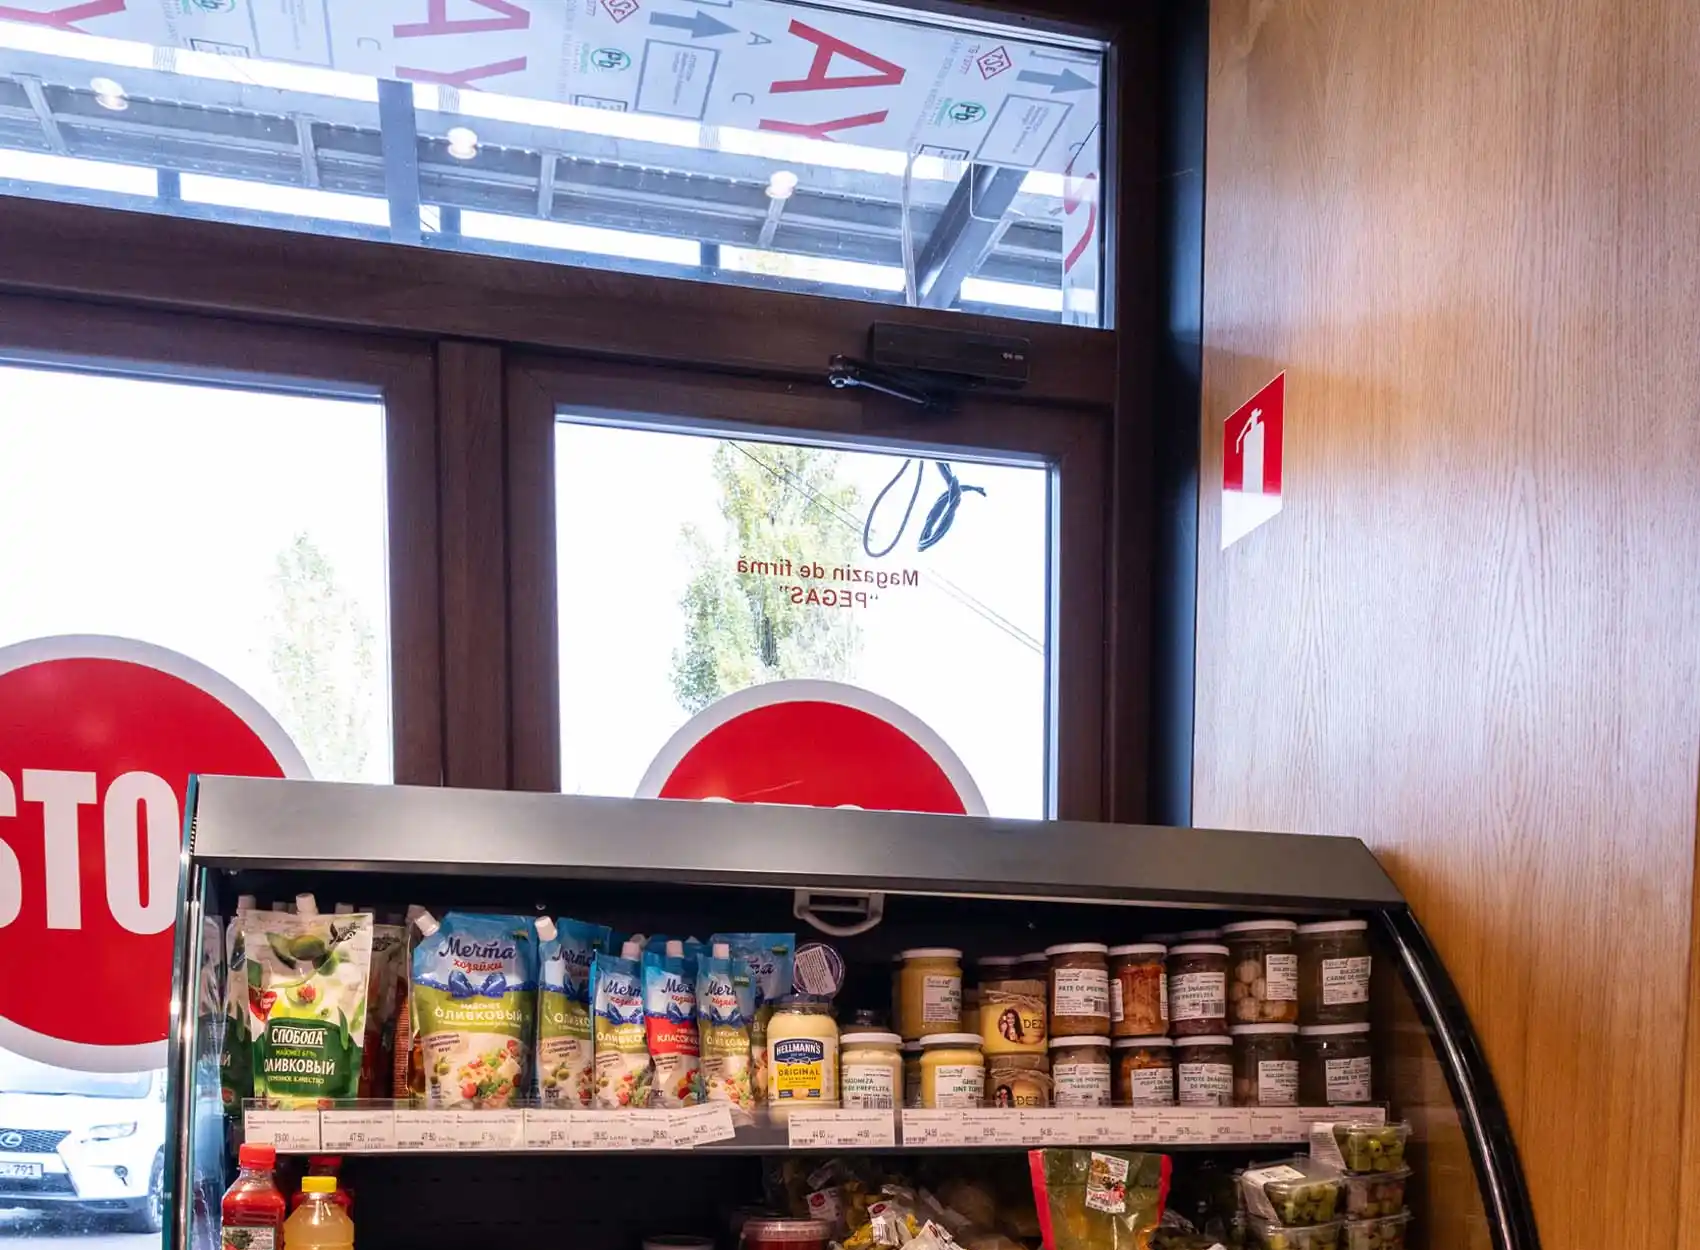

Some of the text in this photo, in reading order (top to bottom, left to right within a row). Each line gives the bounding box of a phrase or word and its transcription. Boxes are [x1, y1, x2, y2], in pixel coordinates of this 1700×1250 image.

[954, 103, 981, 122] Pb
[438, 937, 517, 960] Мечта
[453, 959, 504, 974] хозяйки
[271, 1027, 324, 1045] СЛОБОДА
[776, 1042, 821, 1055] HELLMANN'S
[264, 1058, 336, 1076] ОЛИВКОВЫЙ
[778, 1067, 820, 1077] ORIGINAL
